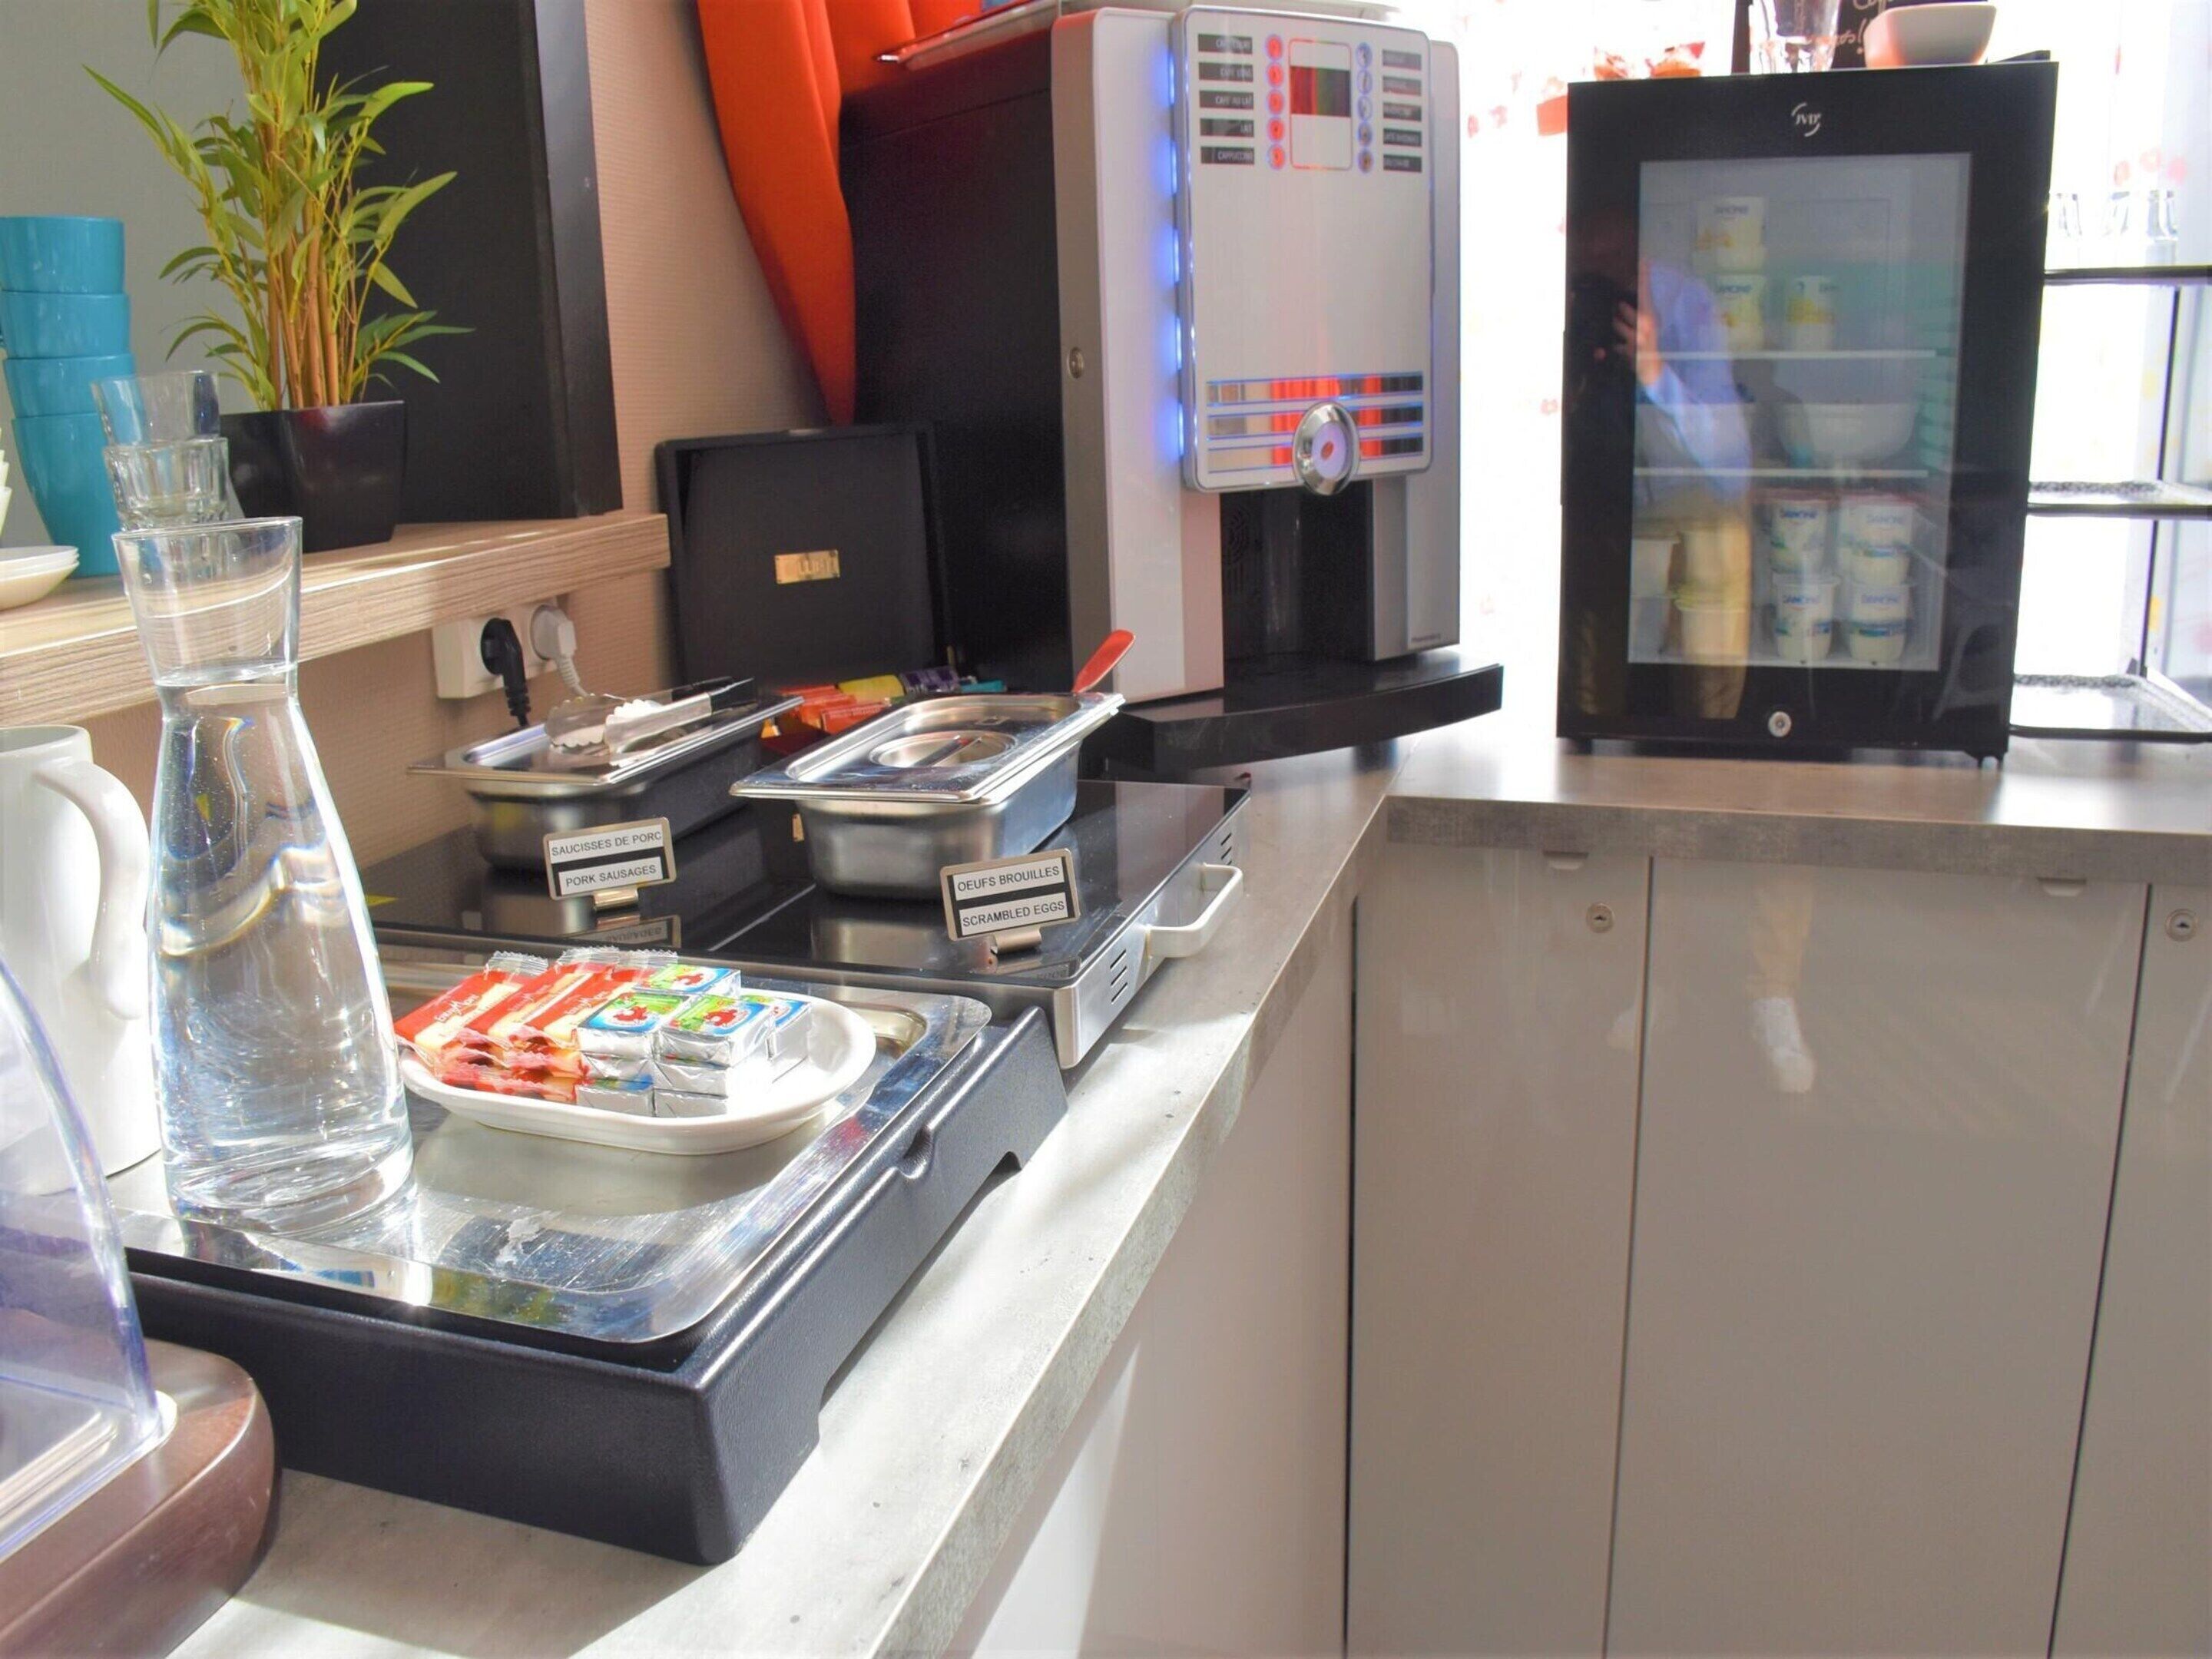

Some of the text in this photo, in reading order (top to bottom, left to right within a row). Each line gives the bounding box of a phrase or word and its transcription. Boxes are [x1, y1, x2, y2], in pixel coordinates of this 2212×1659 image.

[551, 831, 661, 856] SAUCISSES DE PORC
[565, 864, 657, 887] PORK SAUSAGES
[957, 866, 1060, 892] OEUFS BROUILLES
[962, 901, 1065, 927] SCRAMBLED EGGS
